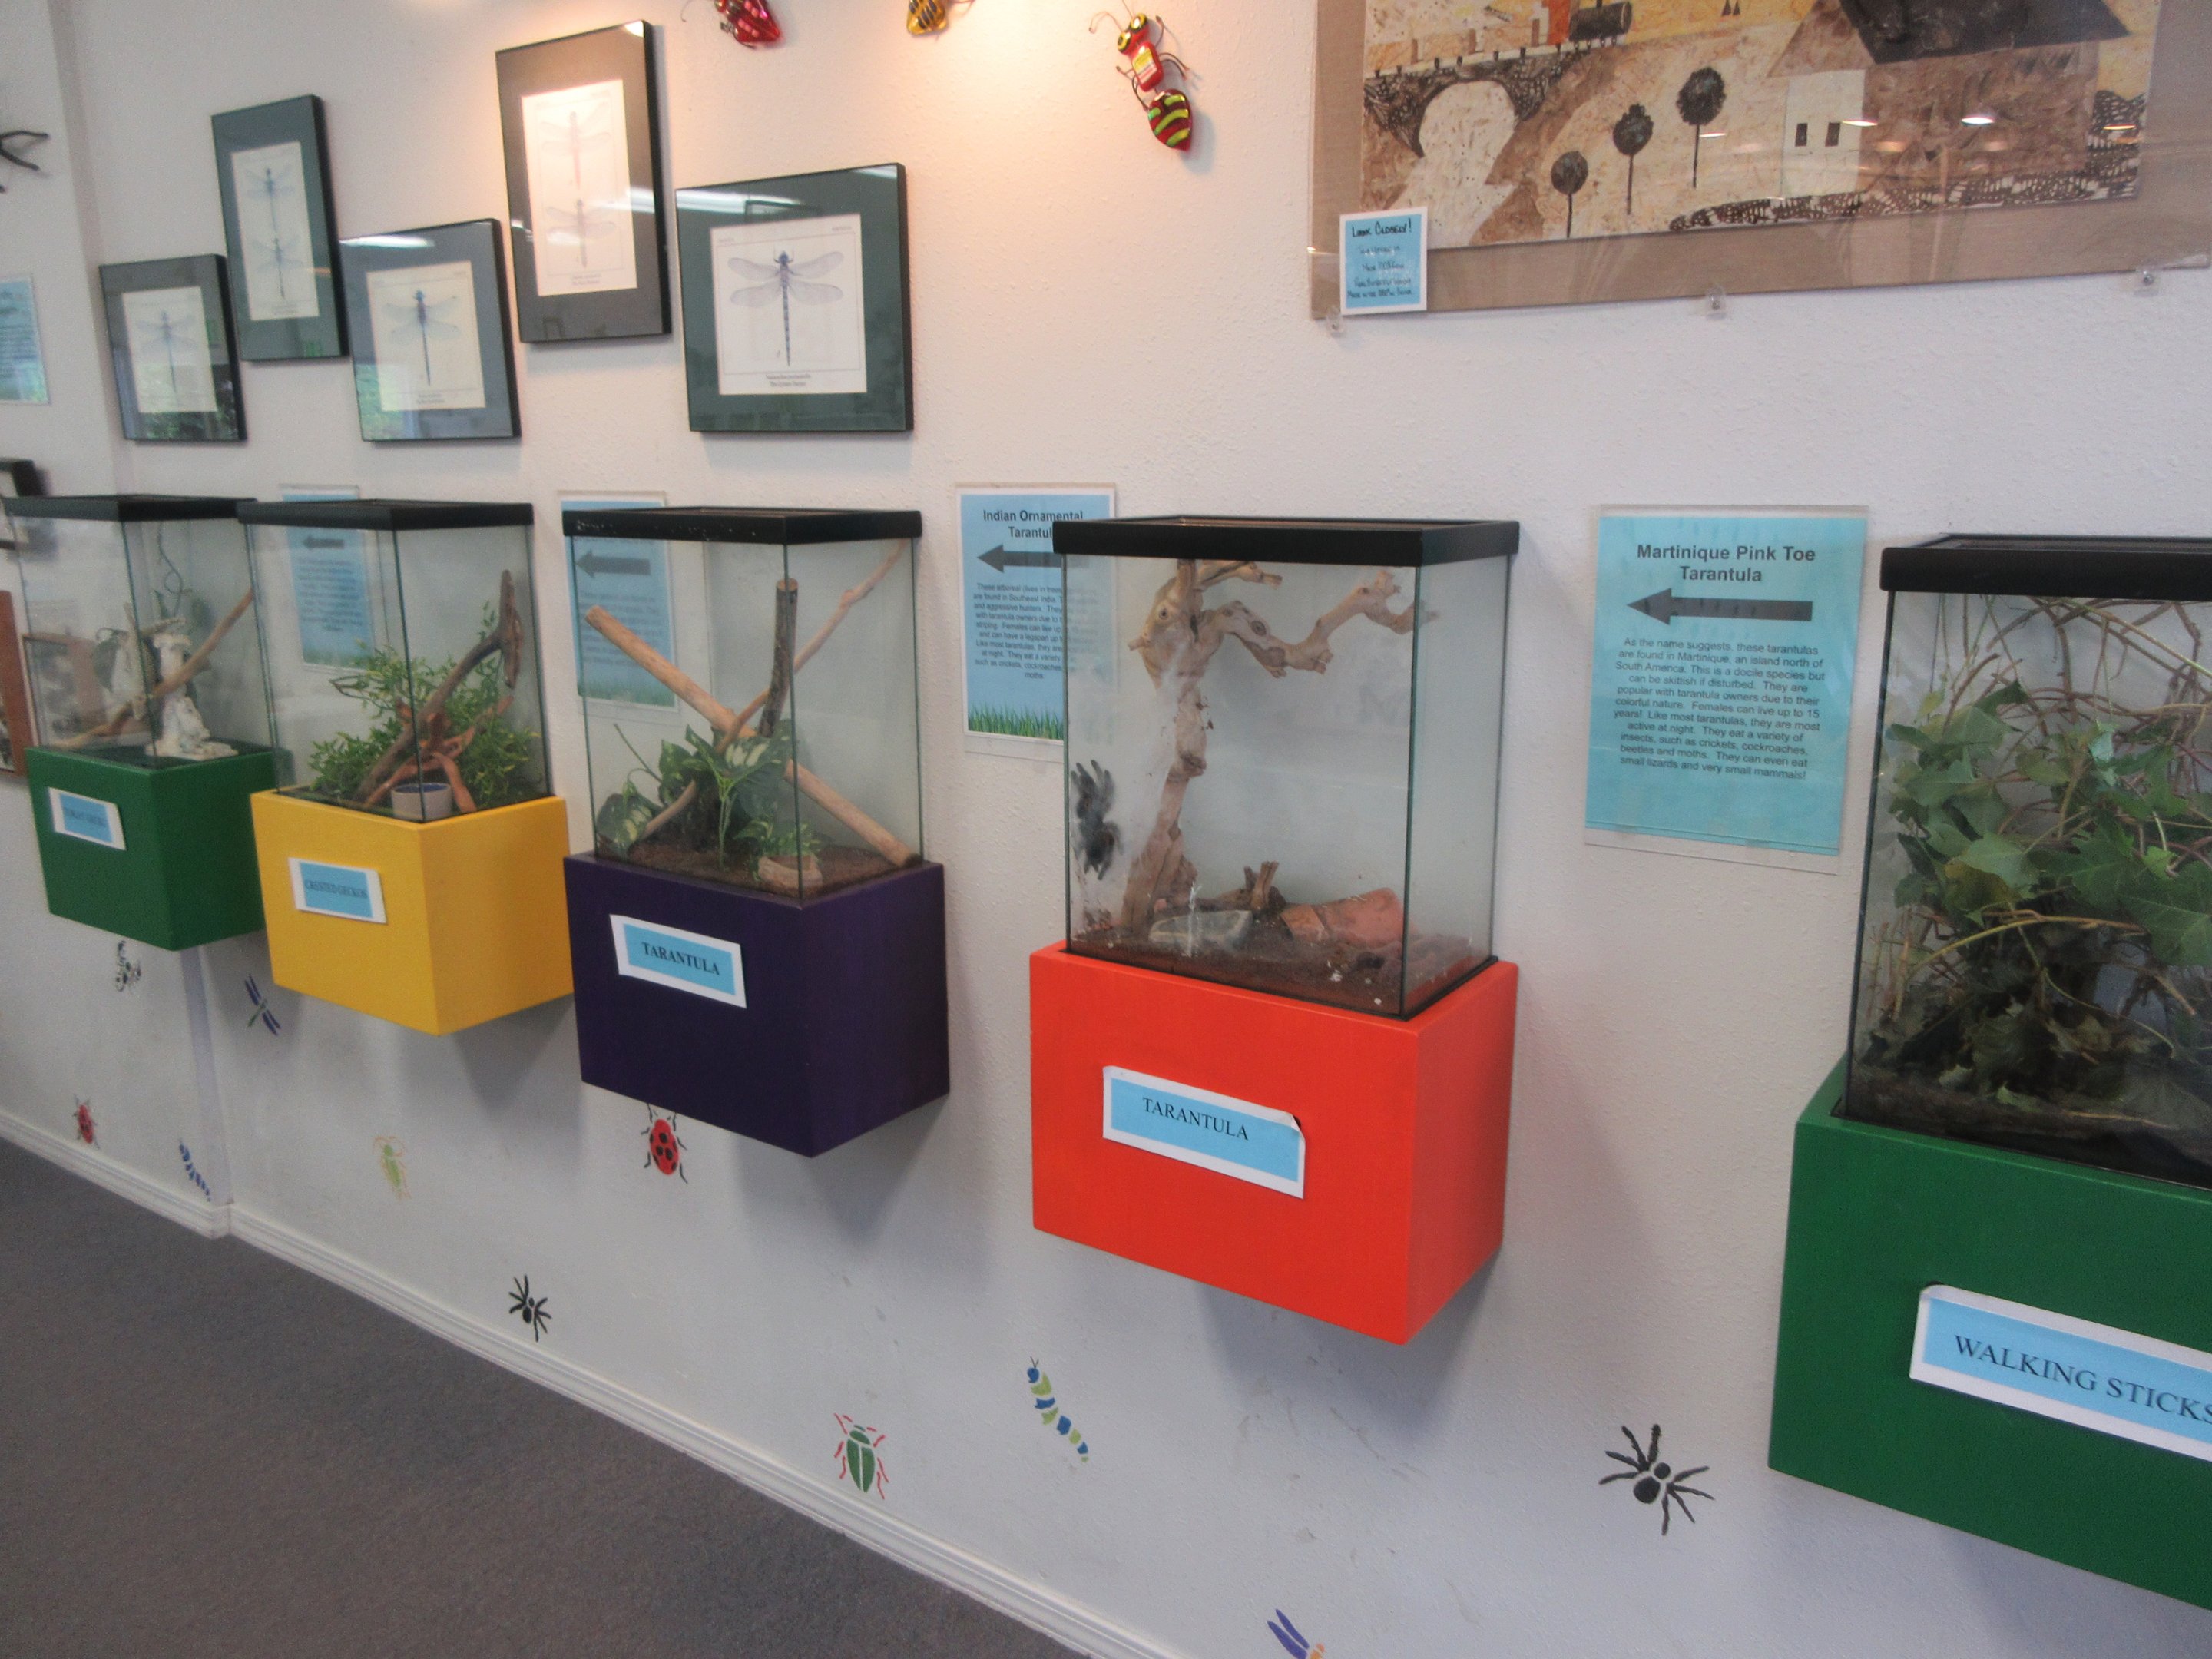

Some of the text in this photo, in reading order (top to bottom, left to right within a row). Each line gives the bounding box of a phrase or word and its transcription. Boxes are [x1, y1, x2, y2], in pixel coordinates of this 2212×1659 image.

[983, 510, 1083, 521] Indian Ornamental
[1008, 526, 1052, 538] Tarantul
[1637, 544, 1815, 562] Martinique Pink Toe
[1680, 565, 1762, 581] Tarantula
[1624, 637, 1819, 655] As the name suggests, these tarantulas
[1637, 650, 1664, 660] found
[1666, 651, 1674, 660] in
[1677, 652, 1731, 664] Martinique,
[1750, 656, 1780, 666] island
[1783, 657, 1810, 667] north
[1813, 658, 1824, 668] of
[1616, 661, 1643, 671] South
[1645, 662, 1686, 673] America.
[1690, 664, 1710, 674] This
[1714, 665, 1722, 675] is
[1734, 667, 1763, 677] docile
[1767, 669, 1805, 680] species
[1808, 671, 1825, 681] but
[1648, 675, 1660, 684] be
[1664, 676, 1697, 685] skittish
[1700, 677, 1705, 686] if
[1707, 677, 1756, 689] disturbed.
[1763, 680, 1788, 694] They
[1790, 684, 1808, 692] are
[1617, 686, 1820, 706] popular with tarantula owners due to their
[1615, 697, 1650, 707] colorful
[1652, 699, 1684, 708] nature.
[1691, 700, 1734, 712] Females
[1757, 706, 1774, 715] live
[1777, 709, 1790, 719] up
[1793, 709, 1803, 717] to
[1806, 709, 1820, 719] 15
[1614, 710, 1642, 719] years!
[1647, 710, 1667, 720] Like
[1671, 713, 1694, 722] most
[1697, 714, 1747, 727] tarantulas,
[1750, 718, 1772, 729] they
[1794, 722, 1820, 731] most
[1627, 722, 1655, 731] active
[1657, 724, 1667, 732] at
[1670, 725, 1695, 735] night.
[1702, 726, 1726, 737] They
[1757, 731, 1790, 743] variety
[1793, 733, 1804, 742] of
[1621, 733, 1656, 743] insects,
[1659, 737, 1682, 745] such
[1699, 739, 1738, 750] crickets,
[1742, 743, 1808, 756] cockroaches,
[1620, 744, 1654, 754] beetles
[1657, 747, 1675, 756] and
[1677, 750, 1708, 759] moths.
[1717, 751, 1740, 763] They
[1763, 757, 1788, 766] even
[1791, 759, 1808, 767] eat
[1620, 757, 1806, 779] small lizards and very small mammals!
[641, 942, 720, 975] TARANTULA
[1142, 1097, 1249, 1141] TARANTULA
[1954, 1335, 2212, 1425] WALKING STICKS
